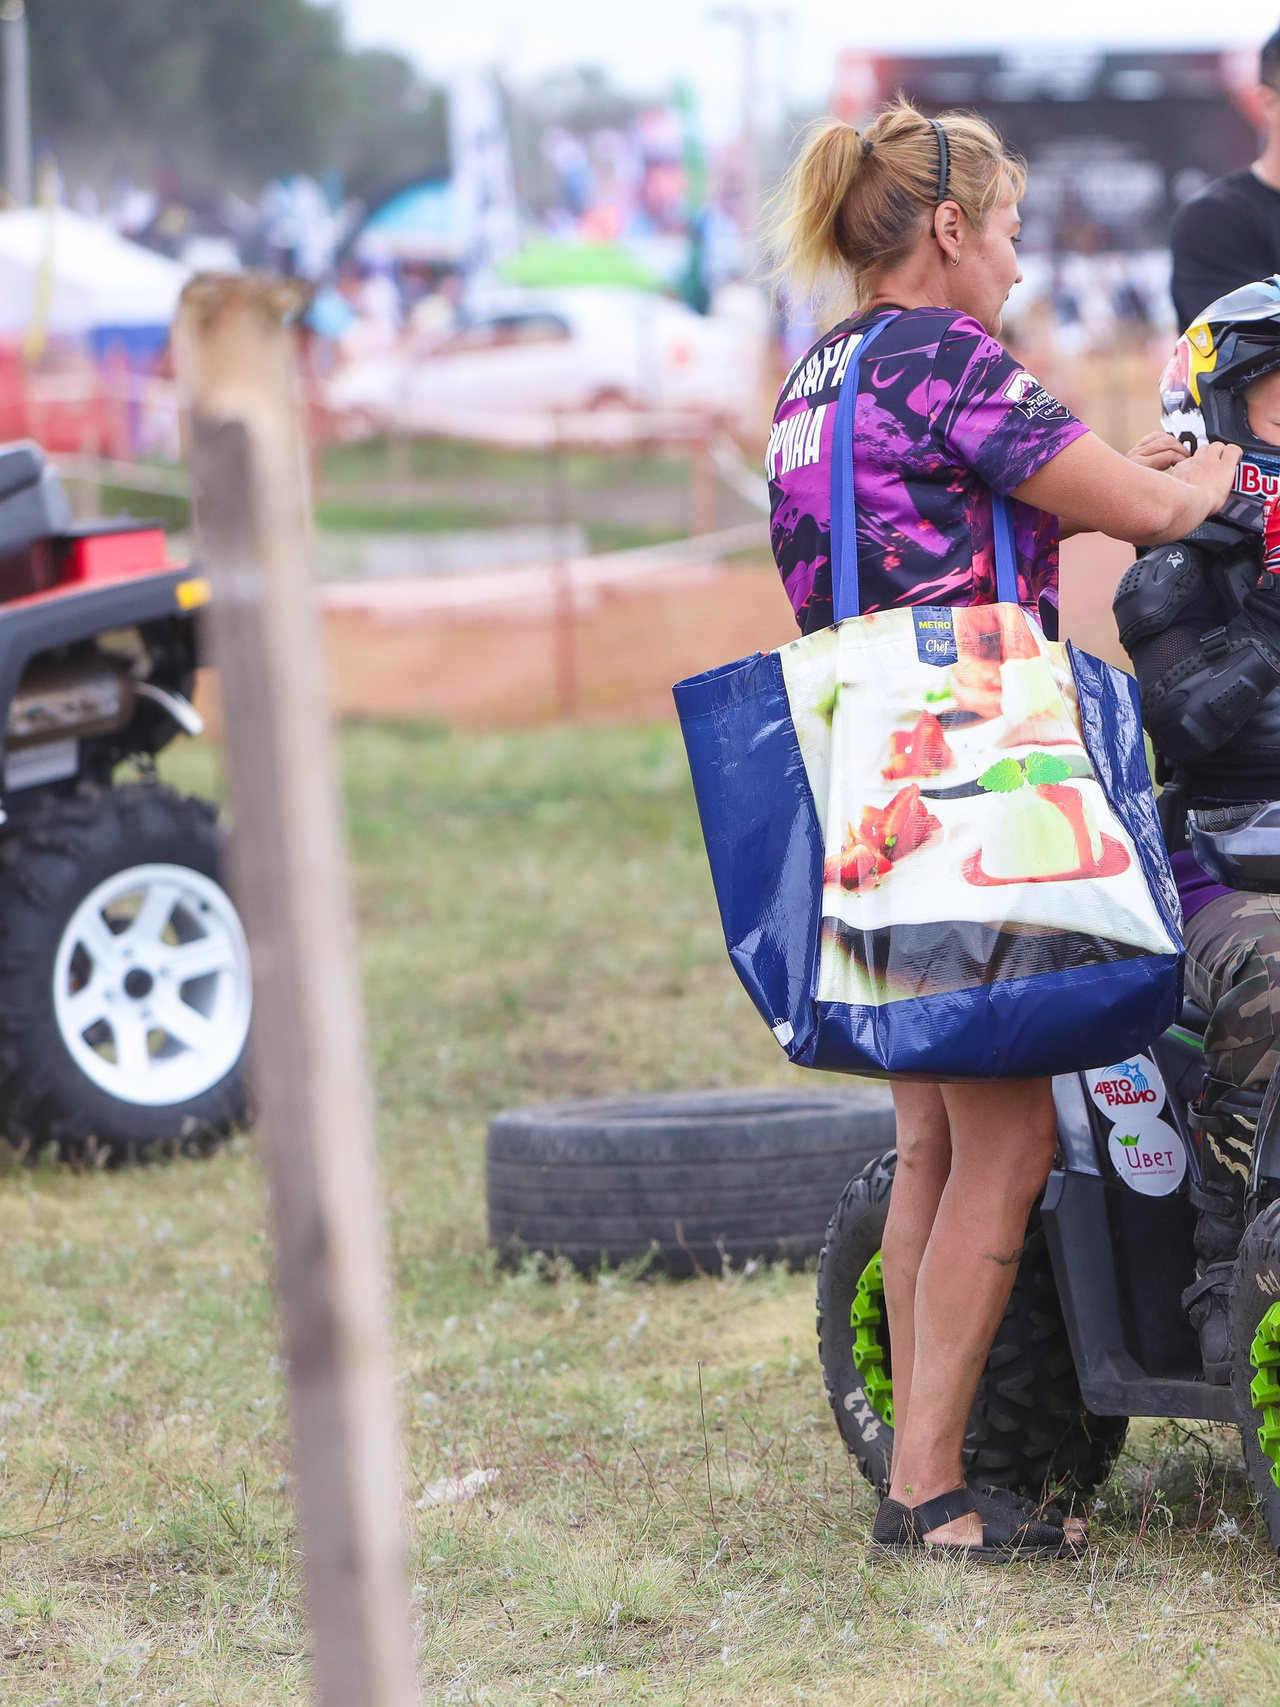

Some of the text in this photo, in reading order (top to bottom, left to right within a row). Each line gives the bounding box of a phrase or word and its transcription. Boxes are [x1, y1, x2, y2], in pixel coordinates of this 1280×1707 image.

[918, 621, 951, 629] METRO
[926, 640, 950, 656] Chef
[1094, 1079, 1132, 1094] АВТО
[1106, 1089, 1157, 1106] РАДИО
